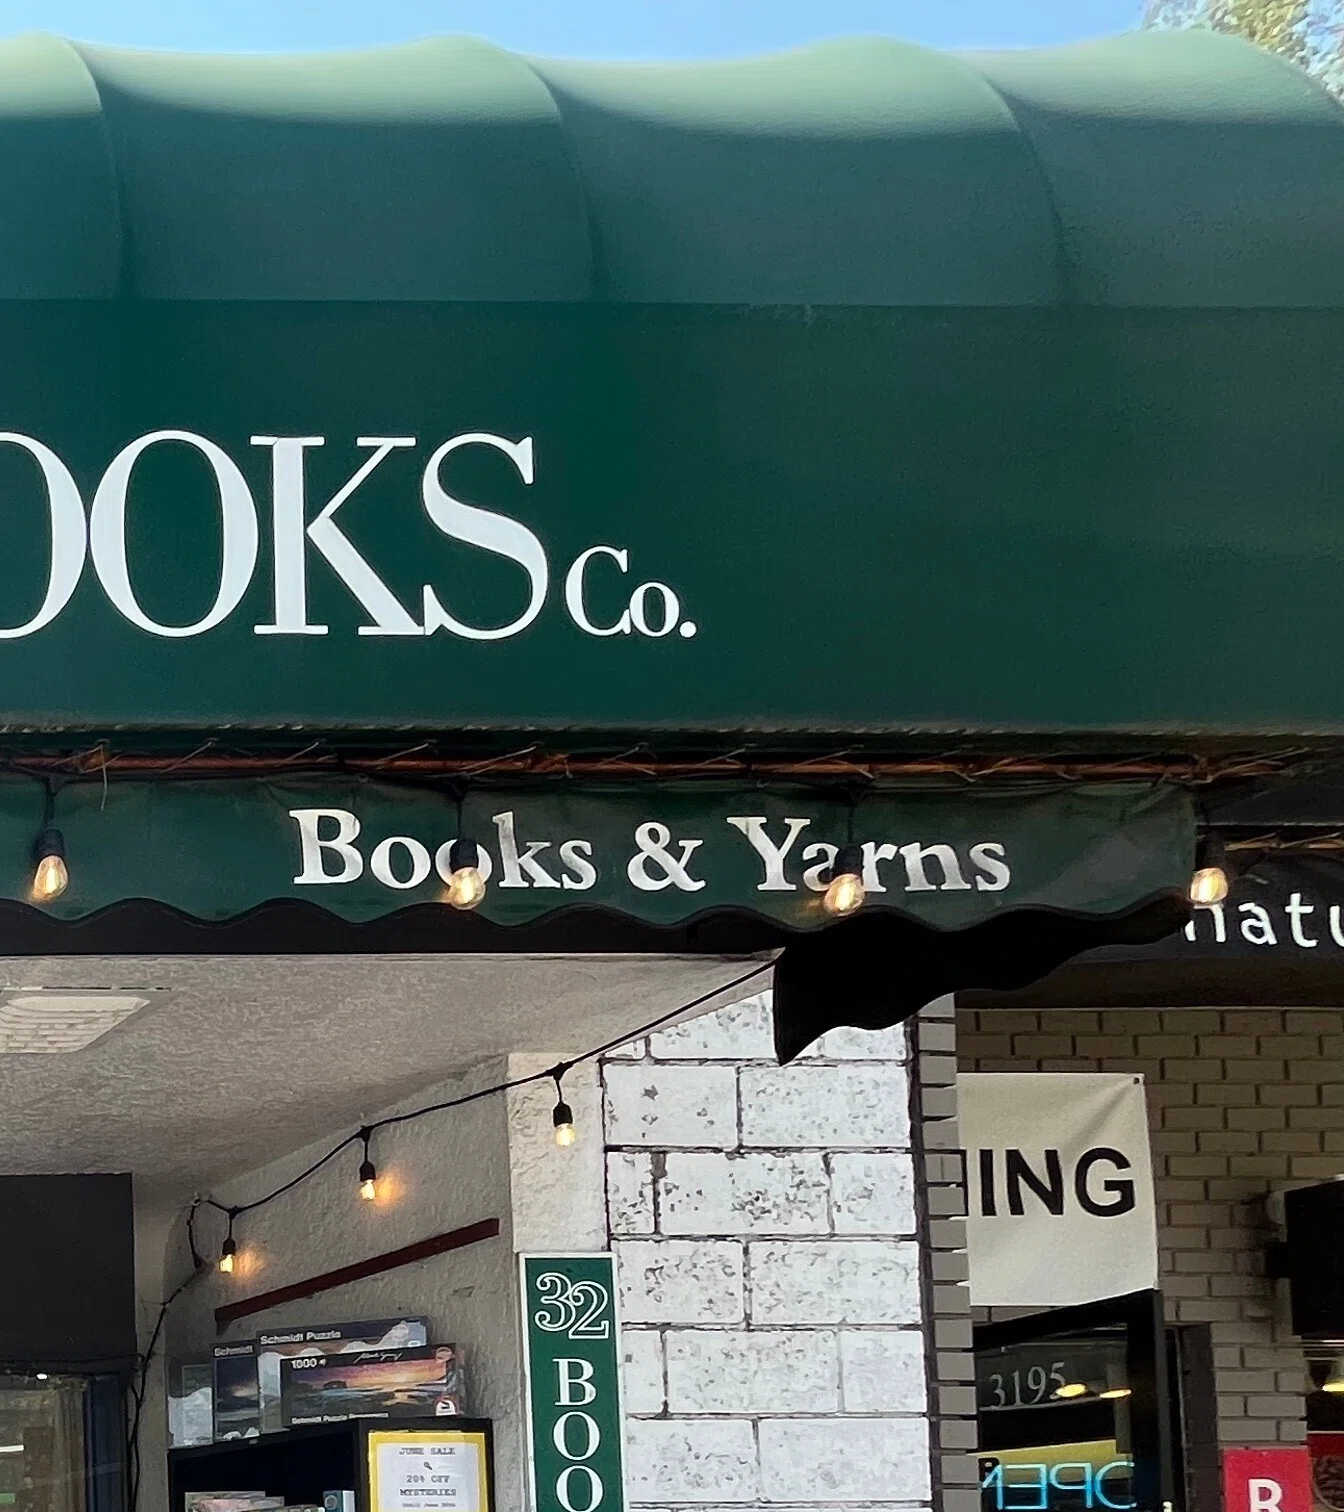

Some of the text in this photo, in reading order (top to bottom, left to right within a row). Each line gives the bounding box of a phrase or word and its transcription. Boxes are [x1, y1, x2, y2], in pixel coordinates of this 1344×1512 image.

[563, 545, 699, 638] Co.
[288, 807, 1012, 893] Books & Yarns
[960, 1146, 1136, 1218] ING
[534, 1271, 610, 1340] 32
[259, 1330, 342, 1345] Schmidt Puzzle
[214, 1345, 253, 1357] Schmidt
[291, 1358, 317, 1369] 1000
[989, 1361, 1066, 1410] 3195
[430, 1447, 455, 1455] SALE
[430, 1475, 451, 1483] OFF
[400, 1488, 456, 1496] MYSTERIES
